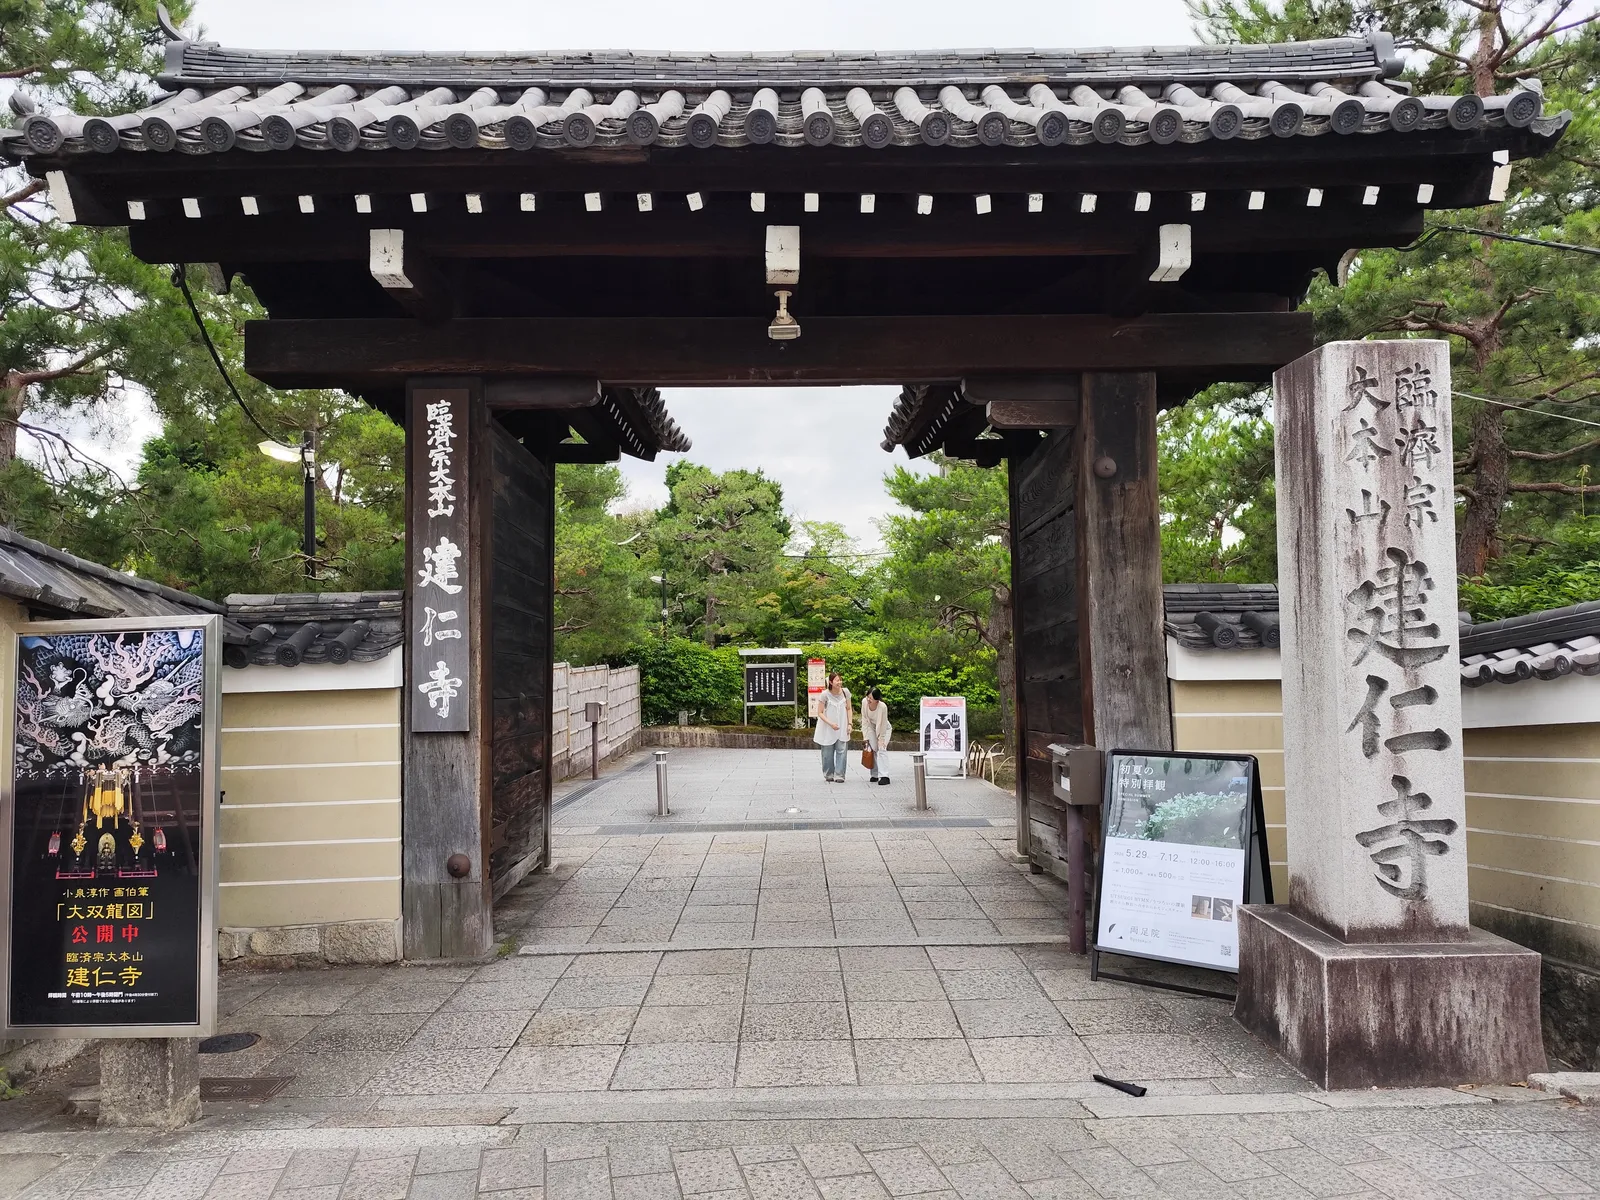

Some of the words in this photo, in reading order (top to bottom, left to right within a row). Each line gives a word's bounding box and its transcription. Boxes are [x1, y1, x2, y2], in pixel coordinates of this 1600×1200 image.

[1343, 365, 1392, 526] 大本山
[418, 536, 462, 718] 建仁寺
[1346, 546, 1459, 901] 建仁寺
[1119, 764, 1154, 775] 初夏の
[1119, 778, 1166, 791] 特別拝観
[1126, 848, 1148, 859] 5.29
[1160, 852, 1179, 862] 7.12
[57, 901, 154, 921] 「大双龍図」
[72, 923, 139, 944] 公開中
[1129, 925, 1160, 939] 両足院
[66, 951, 143, 963] 臨済宗大本山
[66, 965, 143, 987] 建仁寺
